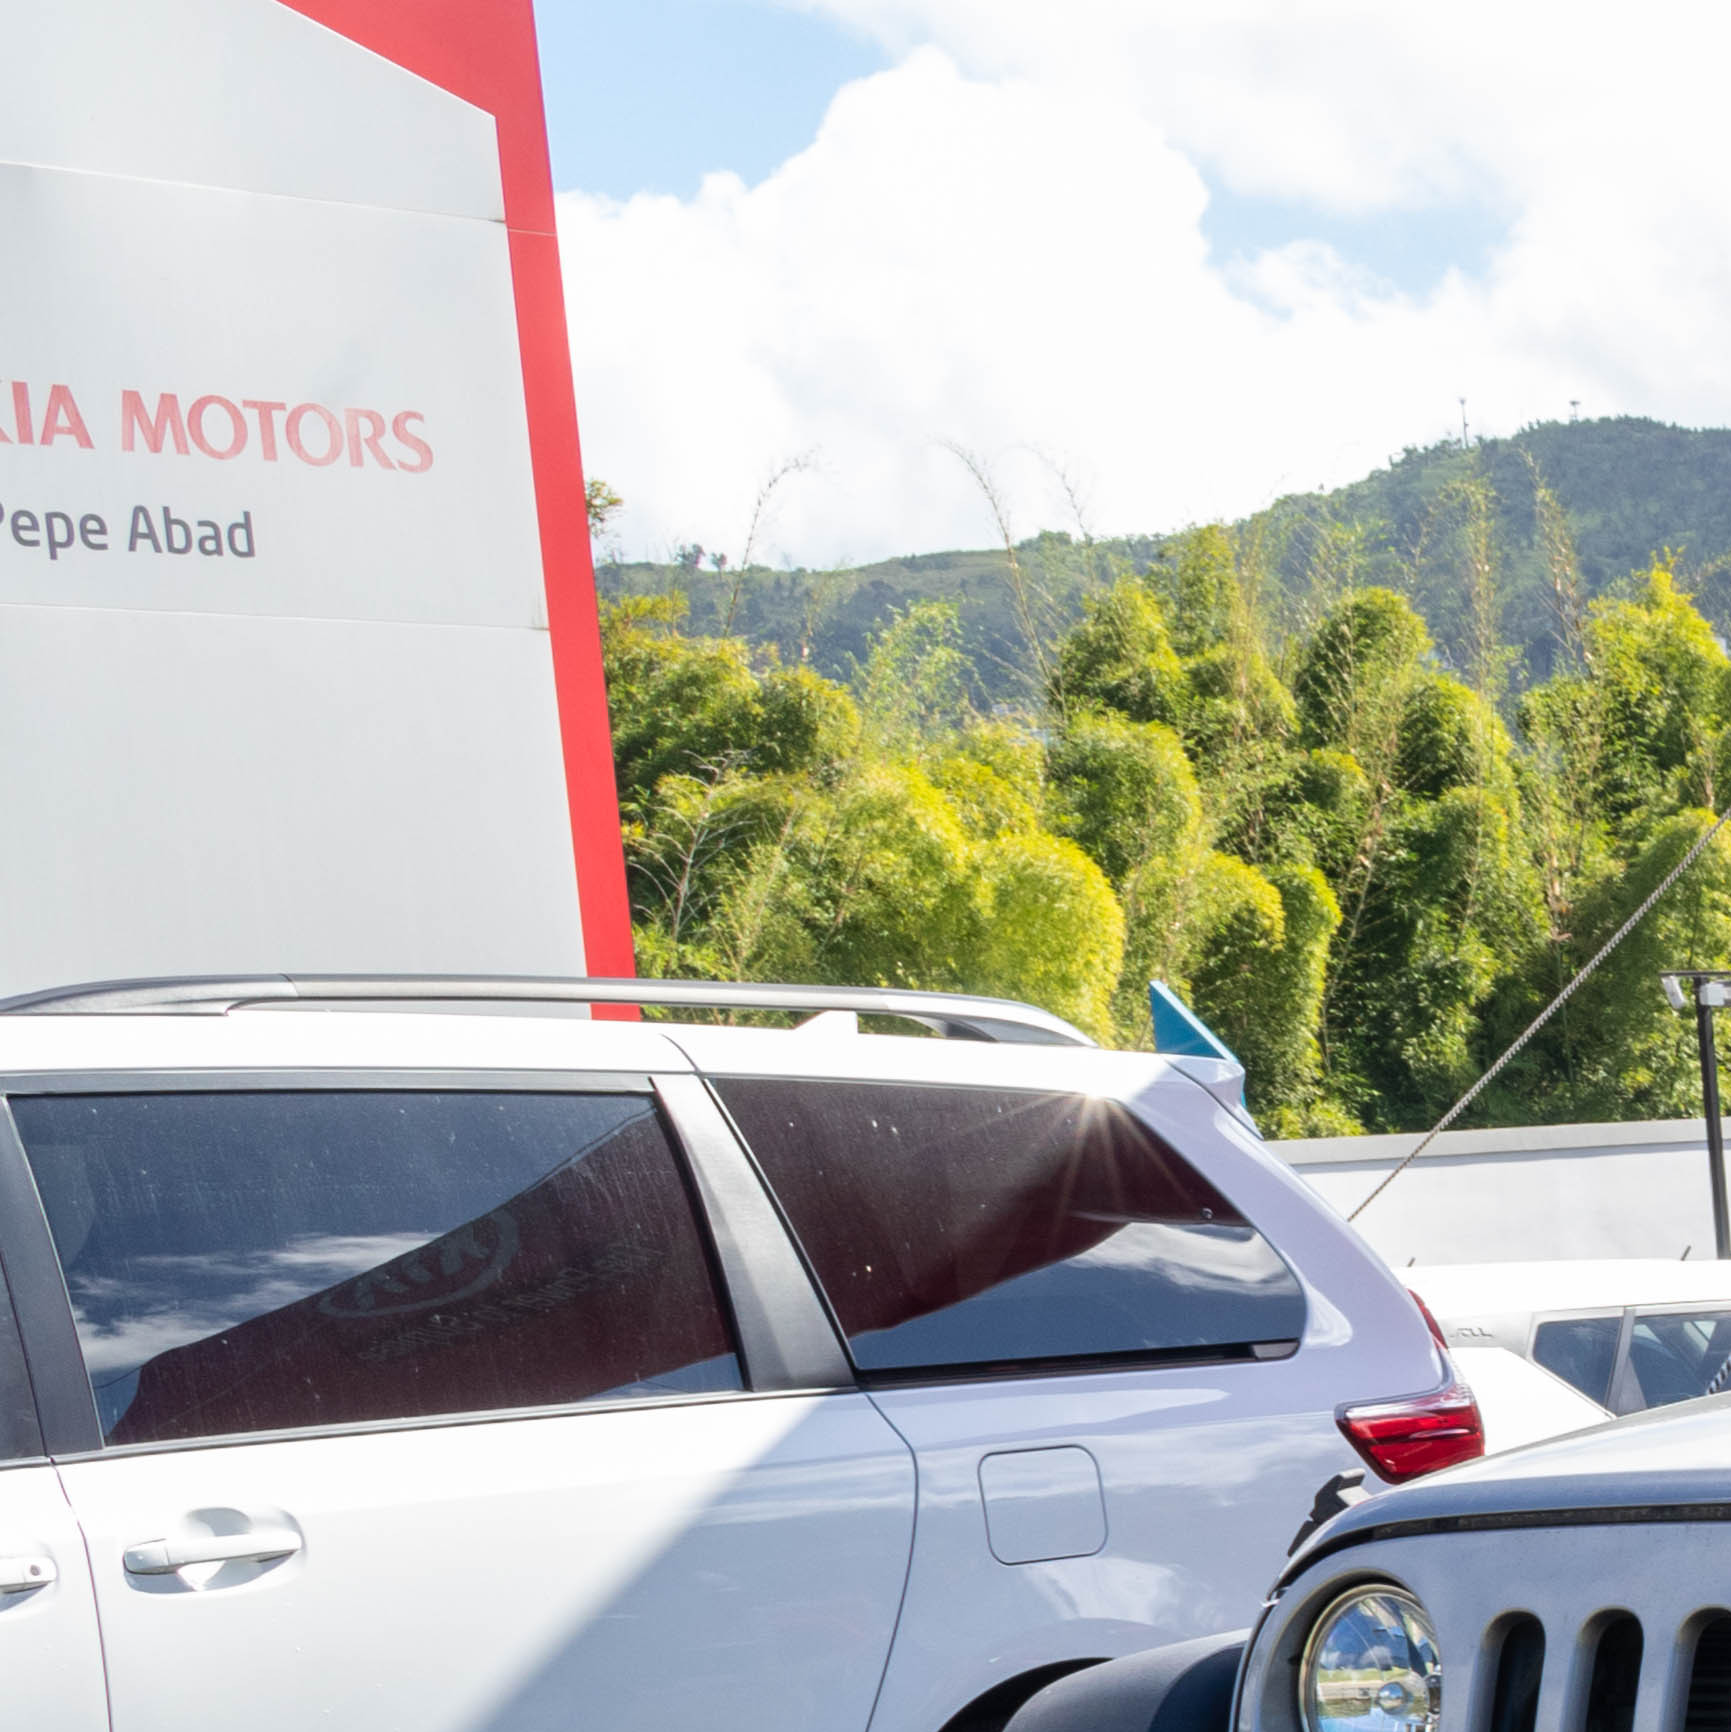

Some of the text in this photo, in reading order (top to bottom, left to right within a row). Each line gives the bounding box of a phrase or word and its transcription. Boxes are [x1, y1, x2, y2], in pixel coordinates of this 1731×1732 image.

[0, 379, 435, 474] IA MOTORS
[0, 502, 256, 560] epe Abad
